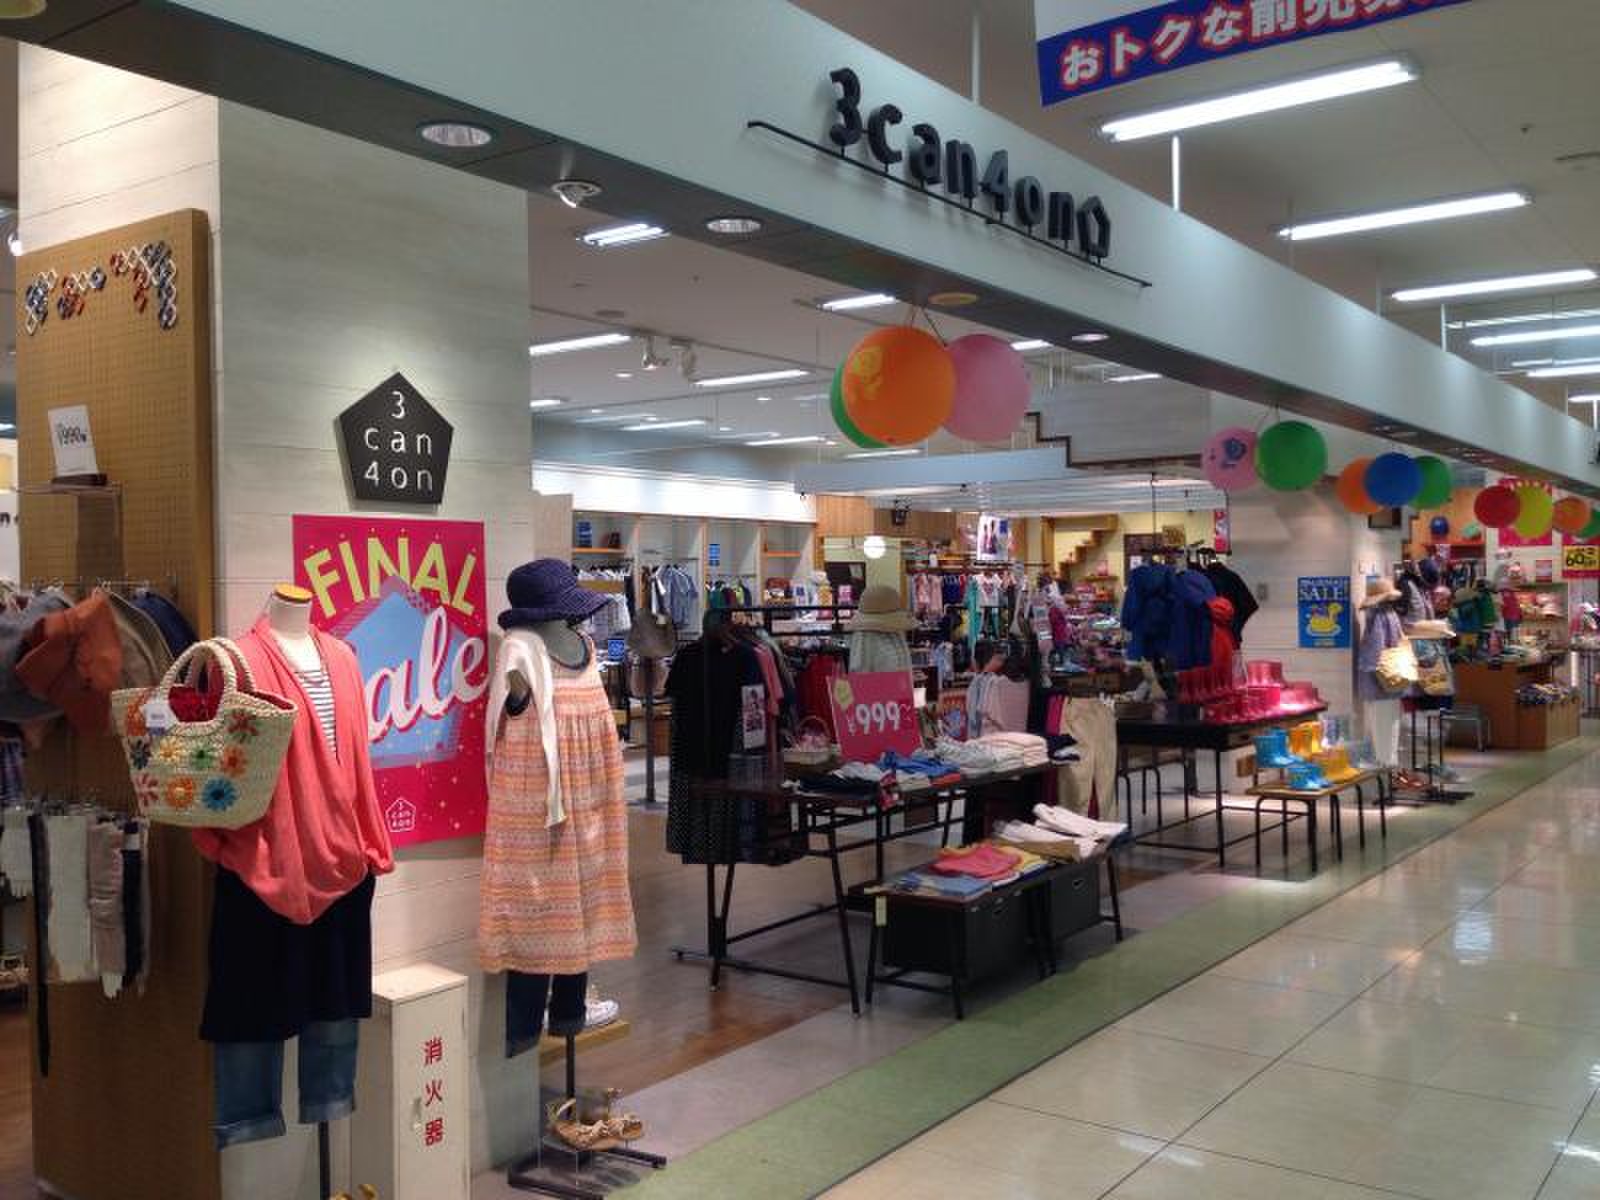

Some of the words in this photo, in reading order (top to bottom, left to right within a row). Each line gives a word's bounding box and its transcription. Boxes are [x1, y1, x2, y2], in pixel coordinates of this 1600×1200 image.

[391, 391, 406, 419] 3
[364, 426, 432, 456] can
[364, 461, 433, 491] 4on
[304, 537, 476, 619] FINAL
[366, 605, 488, 742] ale
[424, 1036, 443, 1146] 消火器
